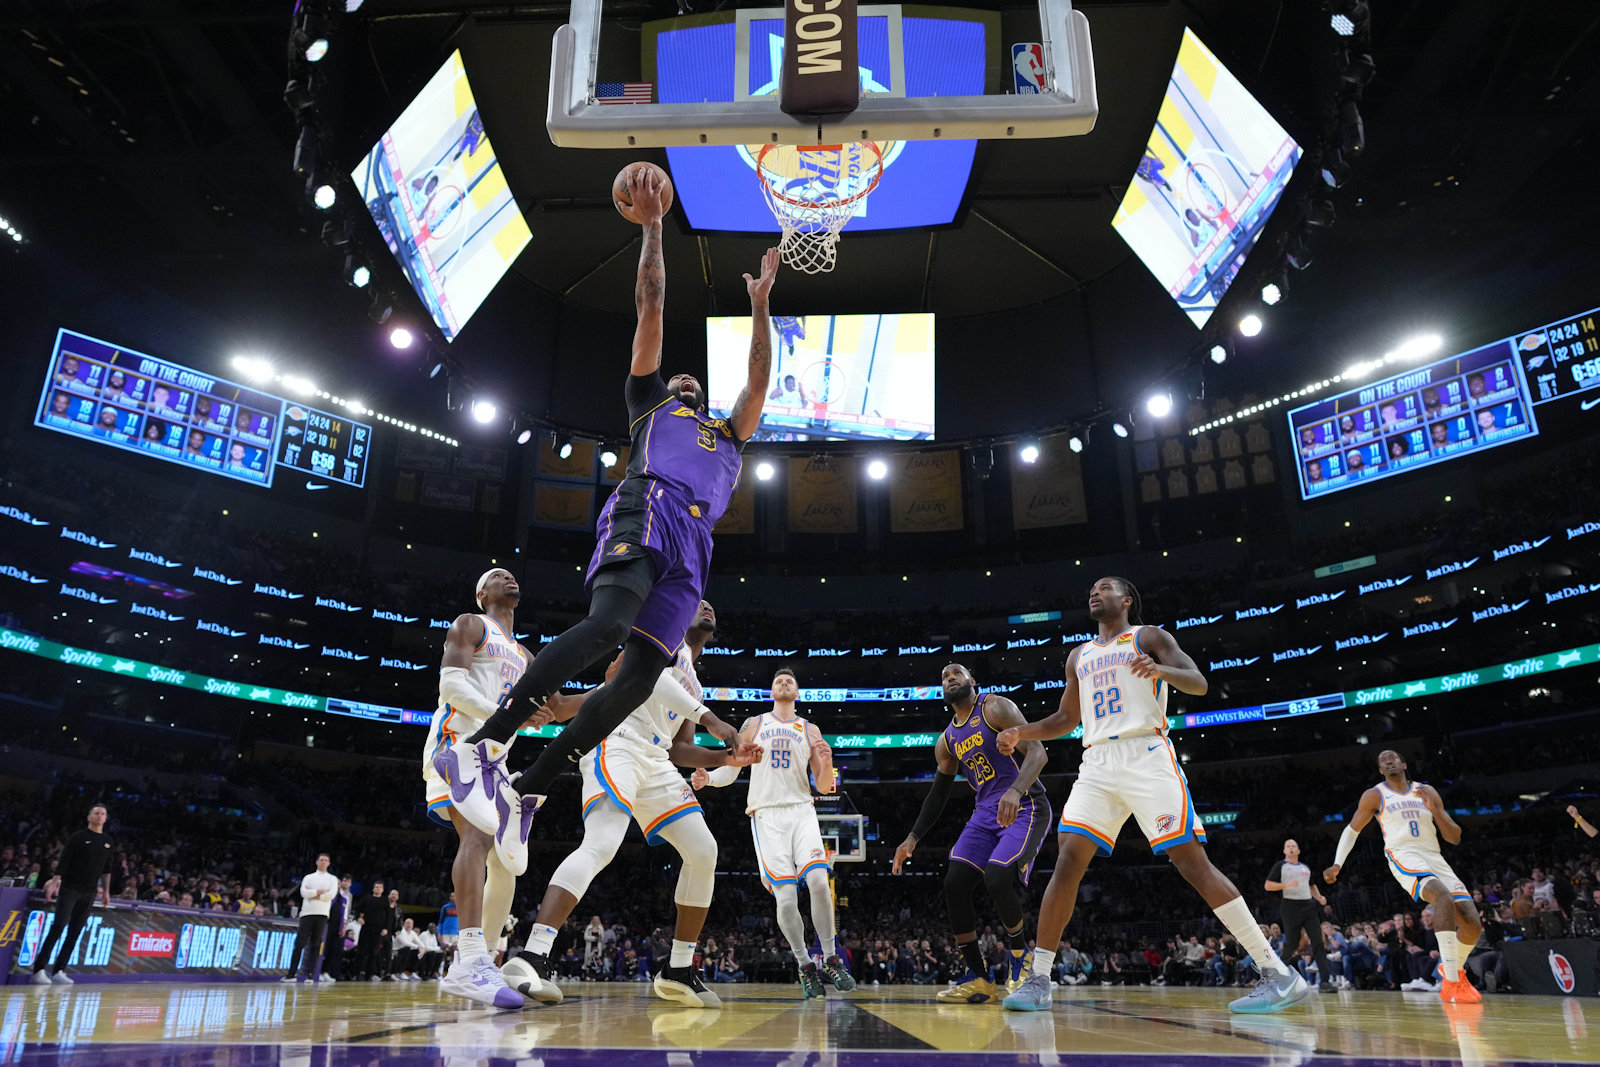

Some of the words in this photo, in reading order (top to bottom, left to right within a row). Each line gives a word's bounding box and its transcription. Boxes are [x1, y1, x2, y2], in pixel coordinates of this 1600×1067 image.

[1549, 327, 1564, 344] 24
[1563, 322, 1579, 339] 24
[1581, 317, 1595, 333] 14
[1554, 346, 1570, 362] 32
[1570, 341, 1585, 357] 19
[90, 365, 102, 379] 11
[139, 358, 159, 377] ON
[159, 363, 180, 381] THE
[178, 371, 215, 393] COURT
[1495, 367, 1504, 381] 8
[135, 379, 146, 392] 9
[1359, 387, 1376, 405] ON
[1375, 381, 1396, 400] THE
[1396, 368, 1432, 393] COURT
[1446, 381, 1460, 396] 10
[178, 392, 190, 406] 11
[1404, 396, 1414, 410] 11
[1363, 409, 1371, 423] 9
[1504, 403, 1512, 418] 7
[127, 413, 139, 427] 11
[309, 414, 320, 427] 24
[320, 417, 330, 430] 24
[332, 420, 341, 434] 14
[355, 427, 366, 442] 62
[1323, 422, 1333, 435] 11
[306, 430, 317, 444] 32
[697, 422, 717, 451] 3
[254, 449, 263, 462] 7
[353, 444, 364, 458] 62
[1369, 443, 1380, 457] 11
[311, 450, 336, 470] 6:56
[1328, 455, 1340, 469] 18
[0, 631, 40, 652] Sprite
[60, 647, 103, 667] Sprite
[147, 665, 186, 684] Sprite
[1503, 658, 1544, 679] Sprite
[1093, 668, 1117, 689] CITY
[1440, 673, 1479, 691] Sprite
[204, 678, 240, 696] Sprite
[891, 689, 905, 699] 62
[282, 692, 318, 709] Sprite
[742, 690, 756, 700] 62
[804, 690, 832, 701] 6:56
[1355, 687, 1393, 705] Sprite
[1092, 686, 1124, 721] 22
[1288, 699, 1320, 714] 8:32
[760, 727, 803, 743] OKLAHOMA
[835, 736, 866, 748] Sprite
[902, 734, 933, 747] Sprite
[771, 738, 791, 748] CITY
[954, 731, 984, 760] LAKERS
[770, 749, 791, 770] 55
[964, 752, 996, 786] 23
[1385, 800, 1428, 814] OKLAHOM
[1401, 810, 1421, 819] CITY
[1409, 820, 1420, 838] 8
[130, 933, 173, 953] Emirates
[187, 925, 217, 968] NBA
[213, 927, 241, 969] CUP
[252, 930, 283, 969] PLAY
